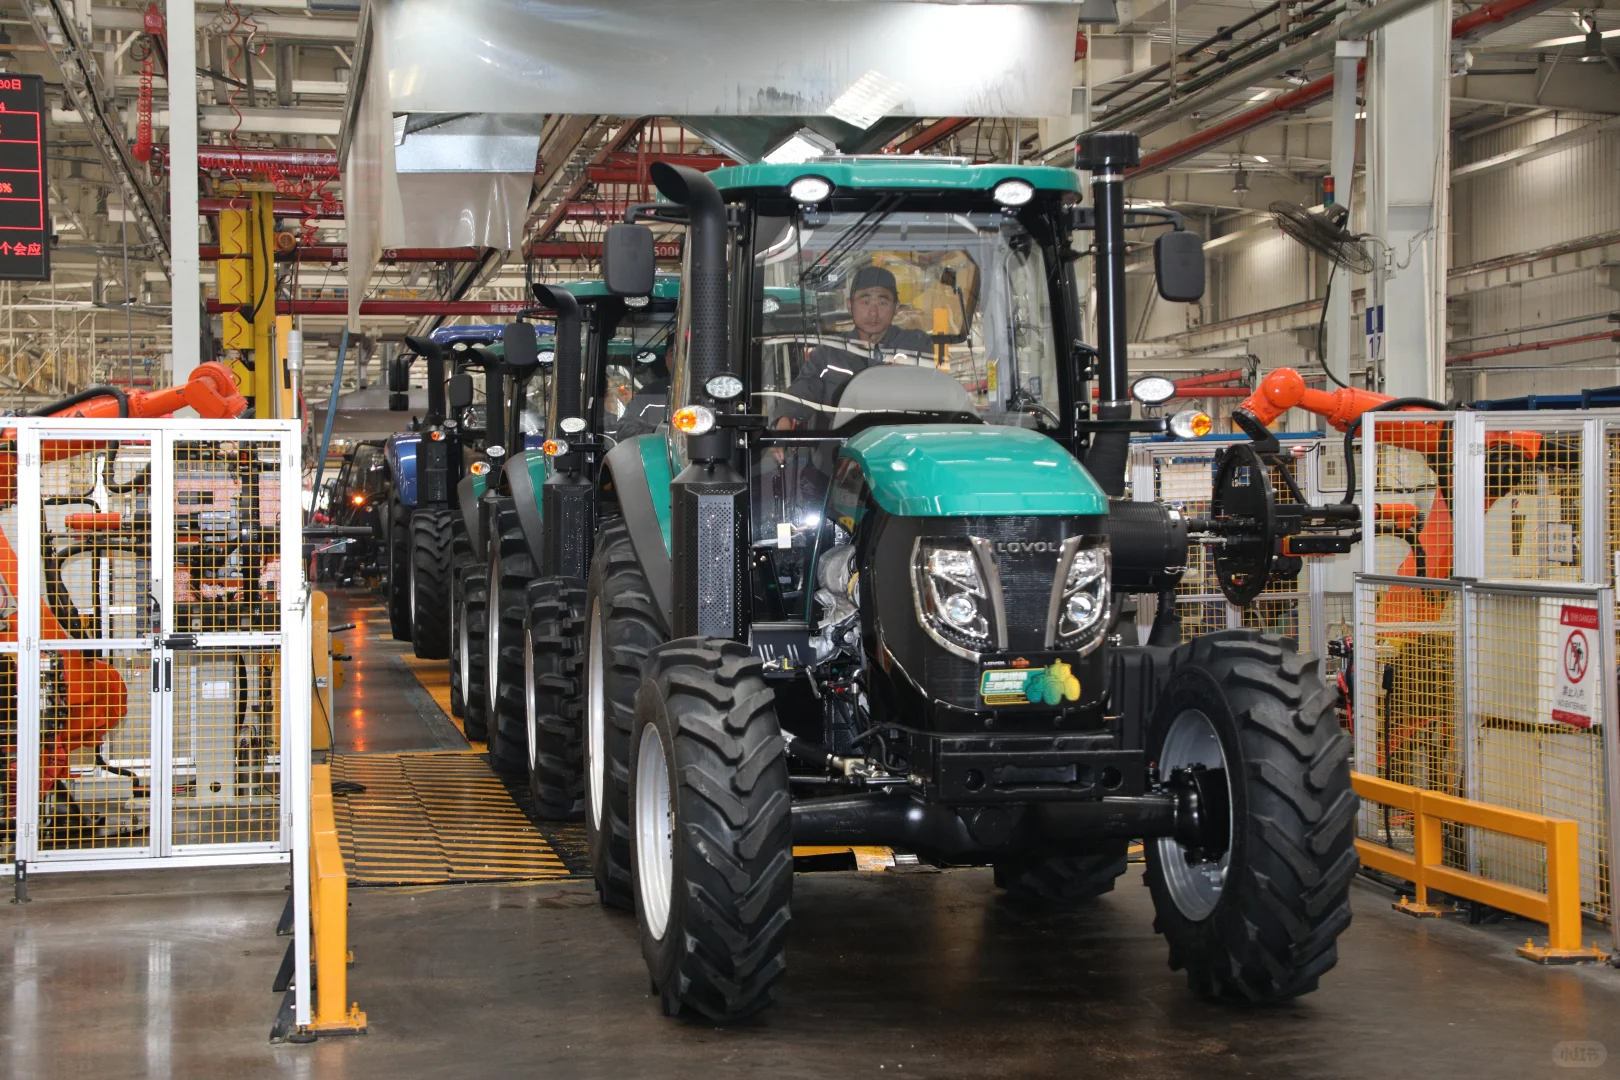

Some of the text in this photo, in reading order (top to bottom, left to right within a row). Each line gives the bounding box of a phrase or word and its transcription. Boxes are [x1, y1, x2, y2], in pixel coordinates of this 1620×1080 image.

[0, 240, 42, 256] 个会应
[997, 541, 1058, 554] LOVOL
[1562, 685, 1585, 699] 禁止入内
